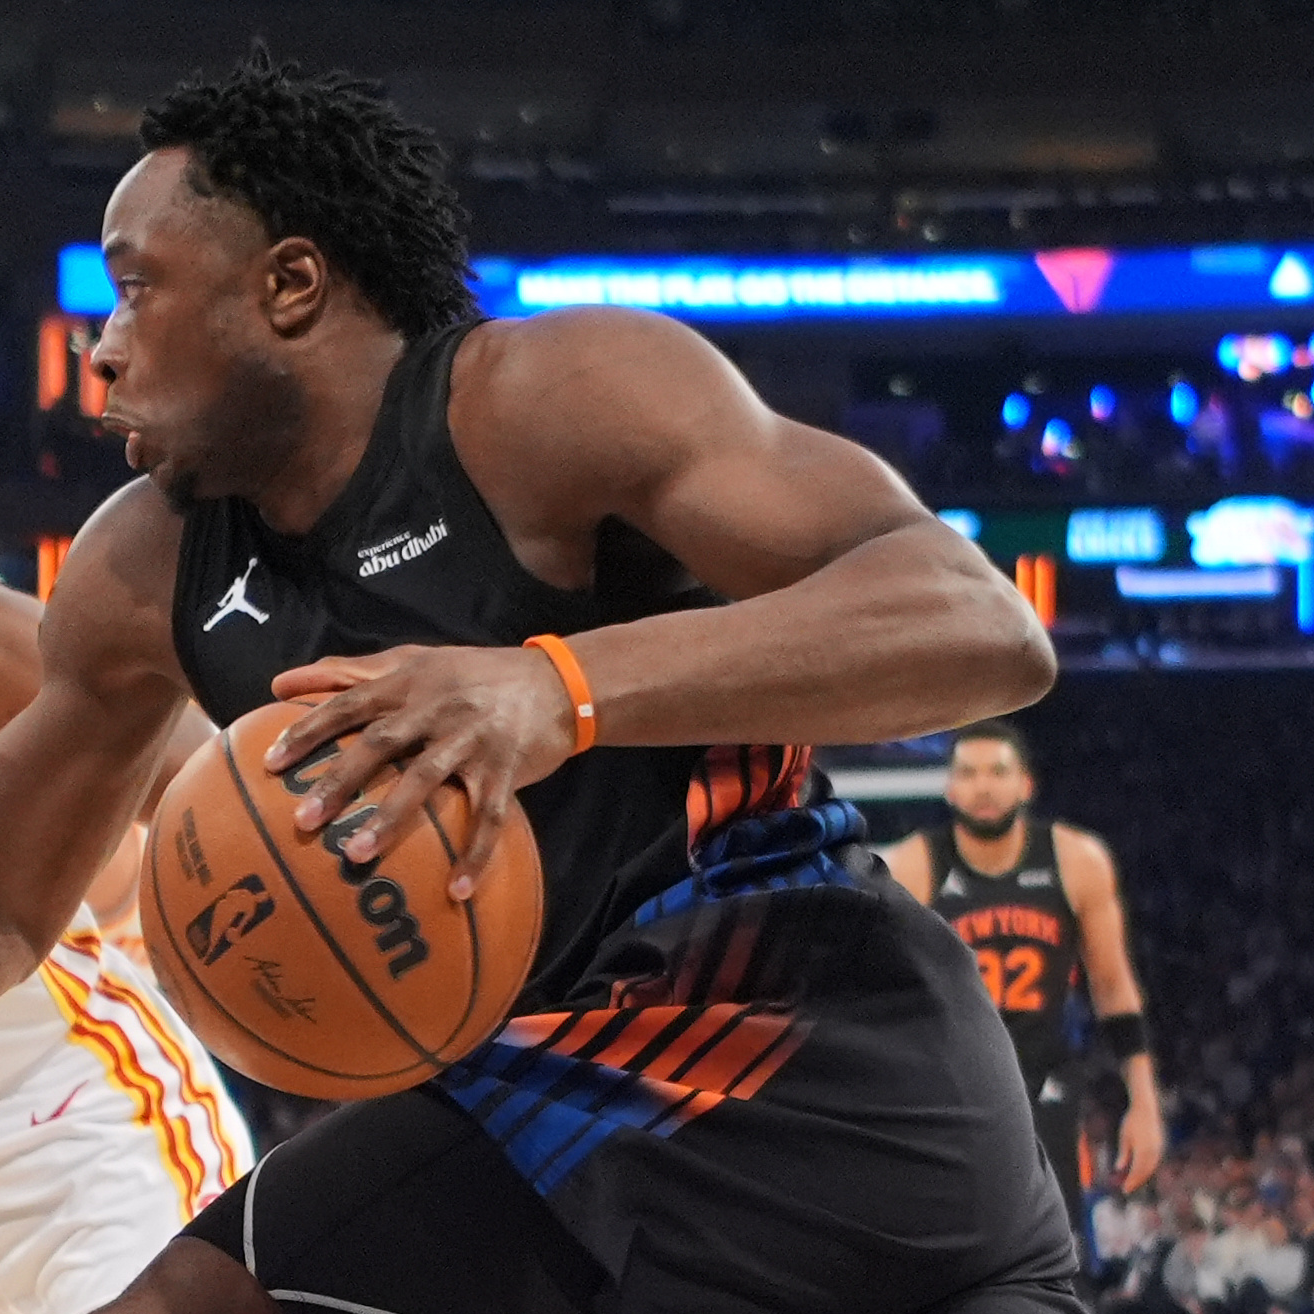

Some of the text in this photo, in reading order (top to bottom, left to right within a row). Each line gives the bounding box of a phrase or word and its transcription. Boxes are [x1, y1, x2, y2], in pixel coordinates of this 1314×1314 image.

[357, 531, 411, 558] experience
[359, 518, 448, 577] abu dhabi
